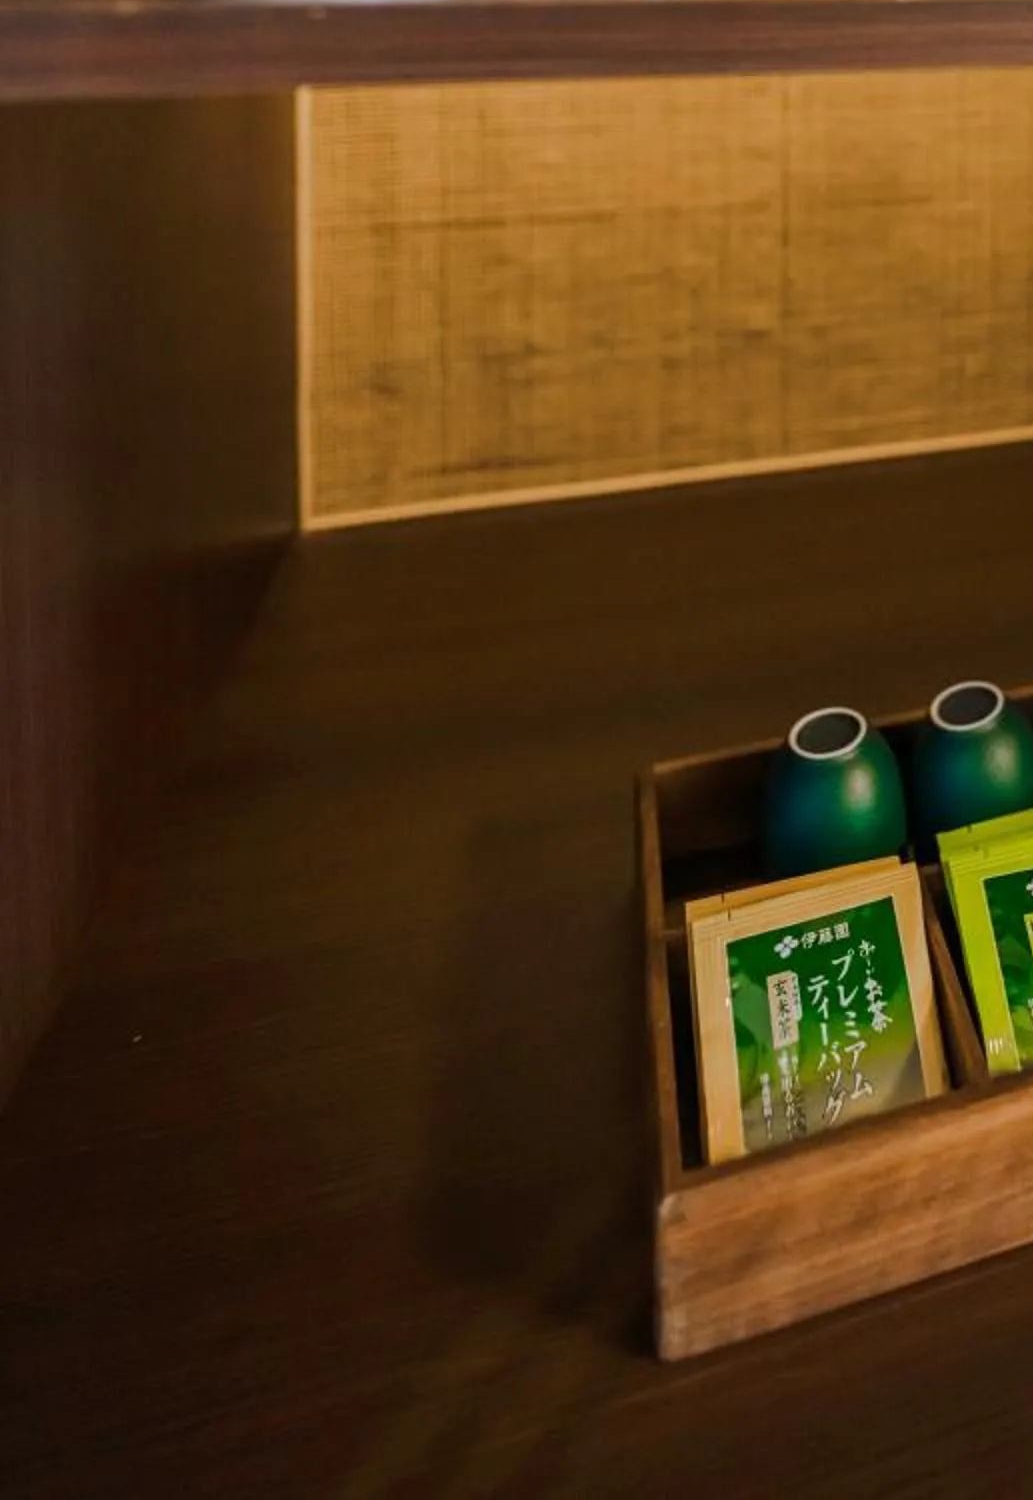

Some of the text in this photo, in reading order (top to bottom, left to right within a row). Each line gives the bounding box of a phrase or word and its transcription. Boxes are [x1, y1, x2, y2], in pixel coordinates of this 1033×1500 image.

[801, 921, 850, 949] 伊藤園
[773, 978, 793, 1040] 玄米茶
[808, 975, 846, 1126] ティーバッグ
[832, 947, 873, 1100] プレミアム
